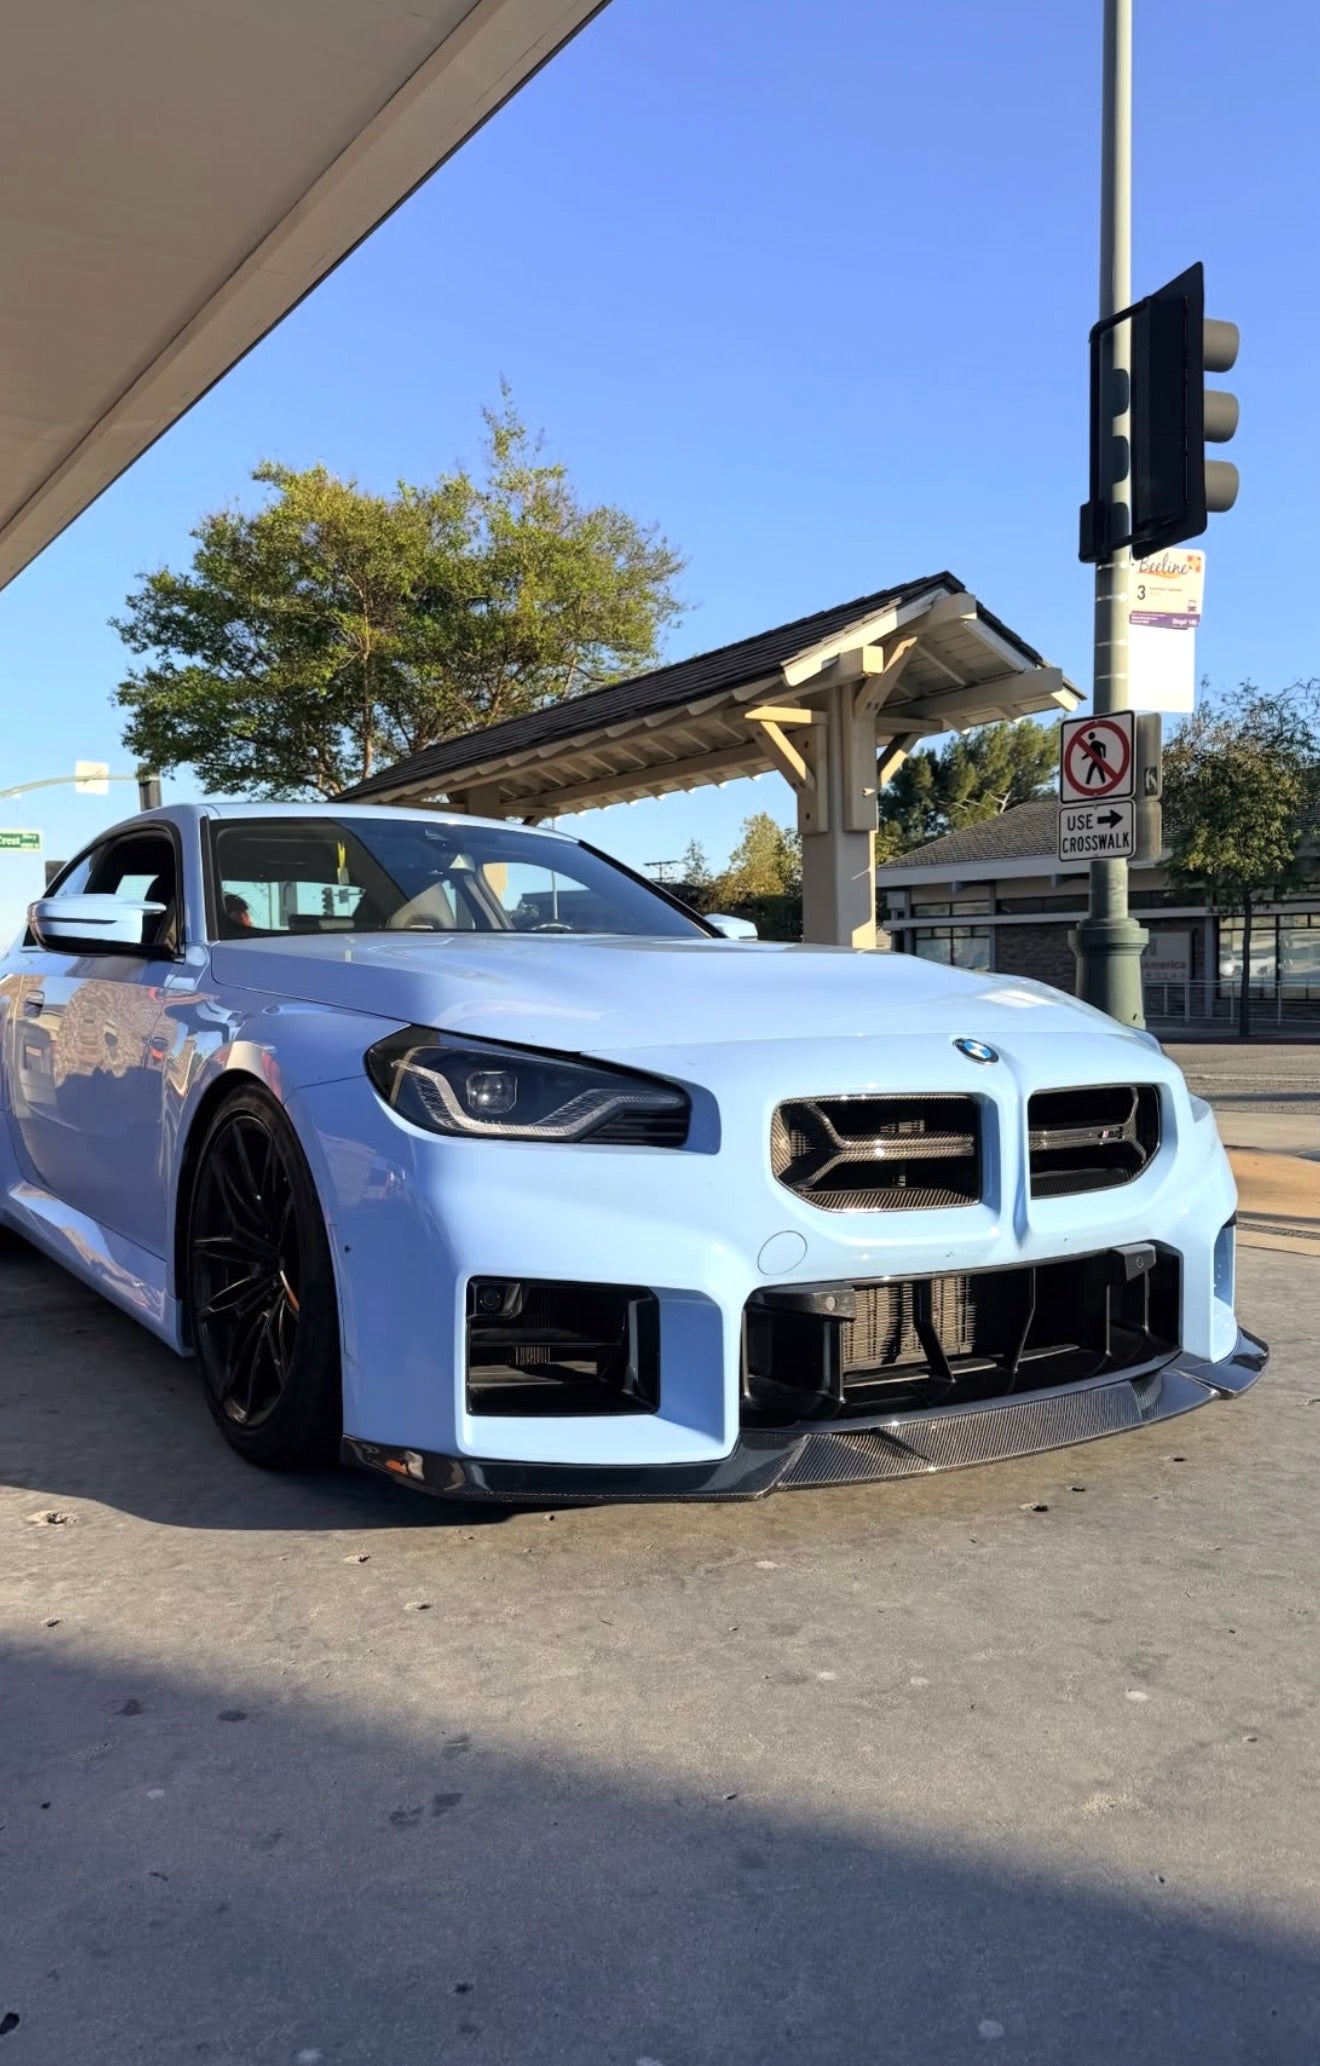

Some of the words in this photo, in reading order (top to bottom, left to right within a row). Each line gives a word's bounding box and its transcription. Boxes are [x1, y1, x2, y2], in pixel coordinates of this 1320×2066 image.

[1139, 552, 1188, 575] Beeline
[1137, 584, 1146, 600] 3
[1067, 813, 1094, 831] USE
[1062, 832, 1130, 853] CROSSWALK
